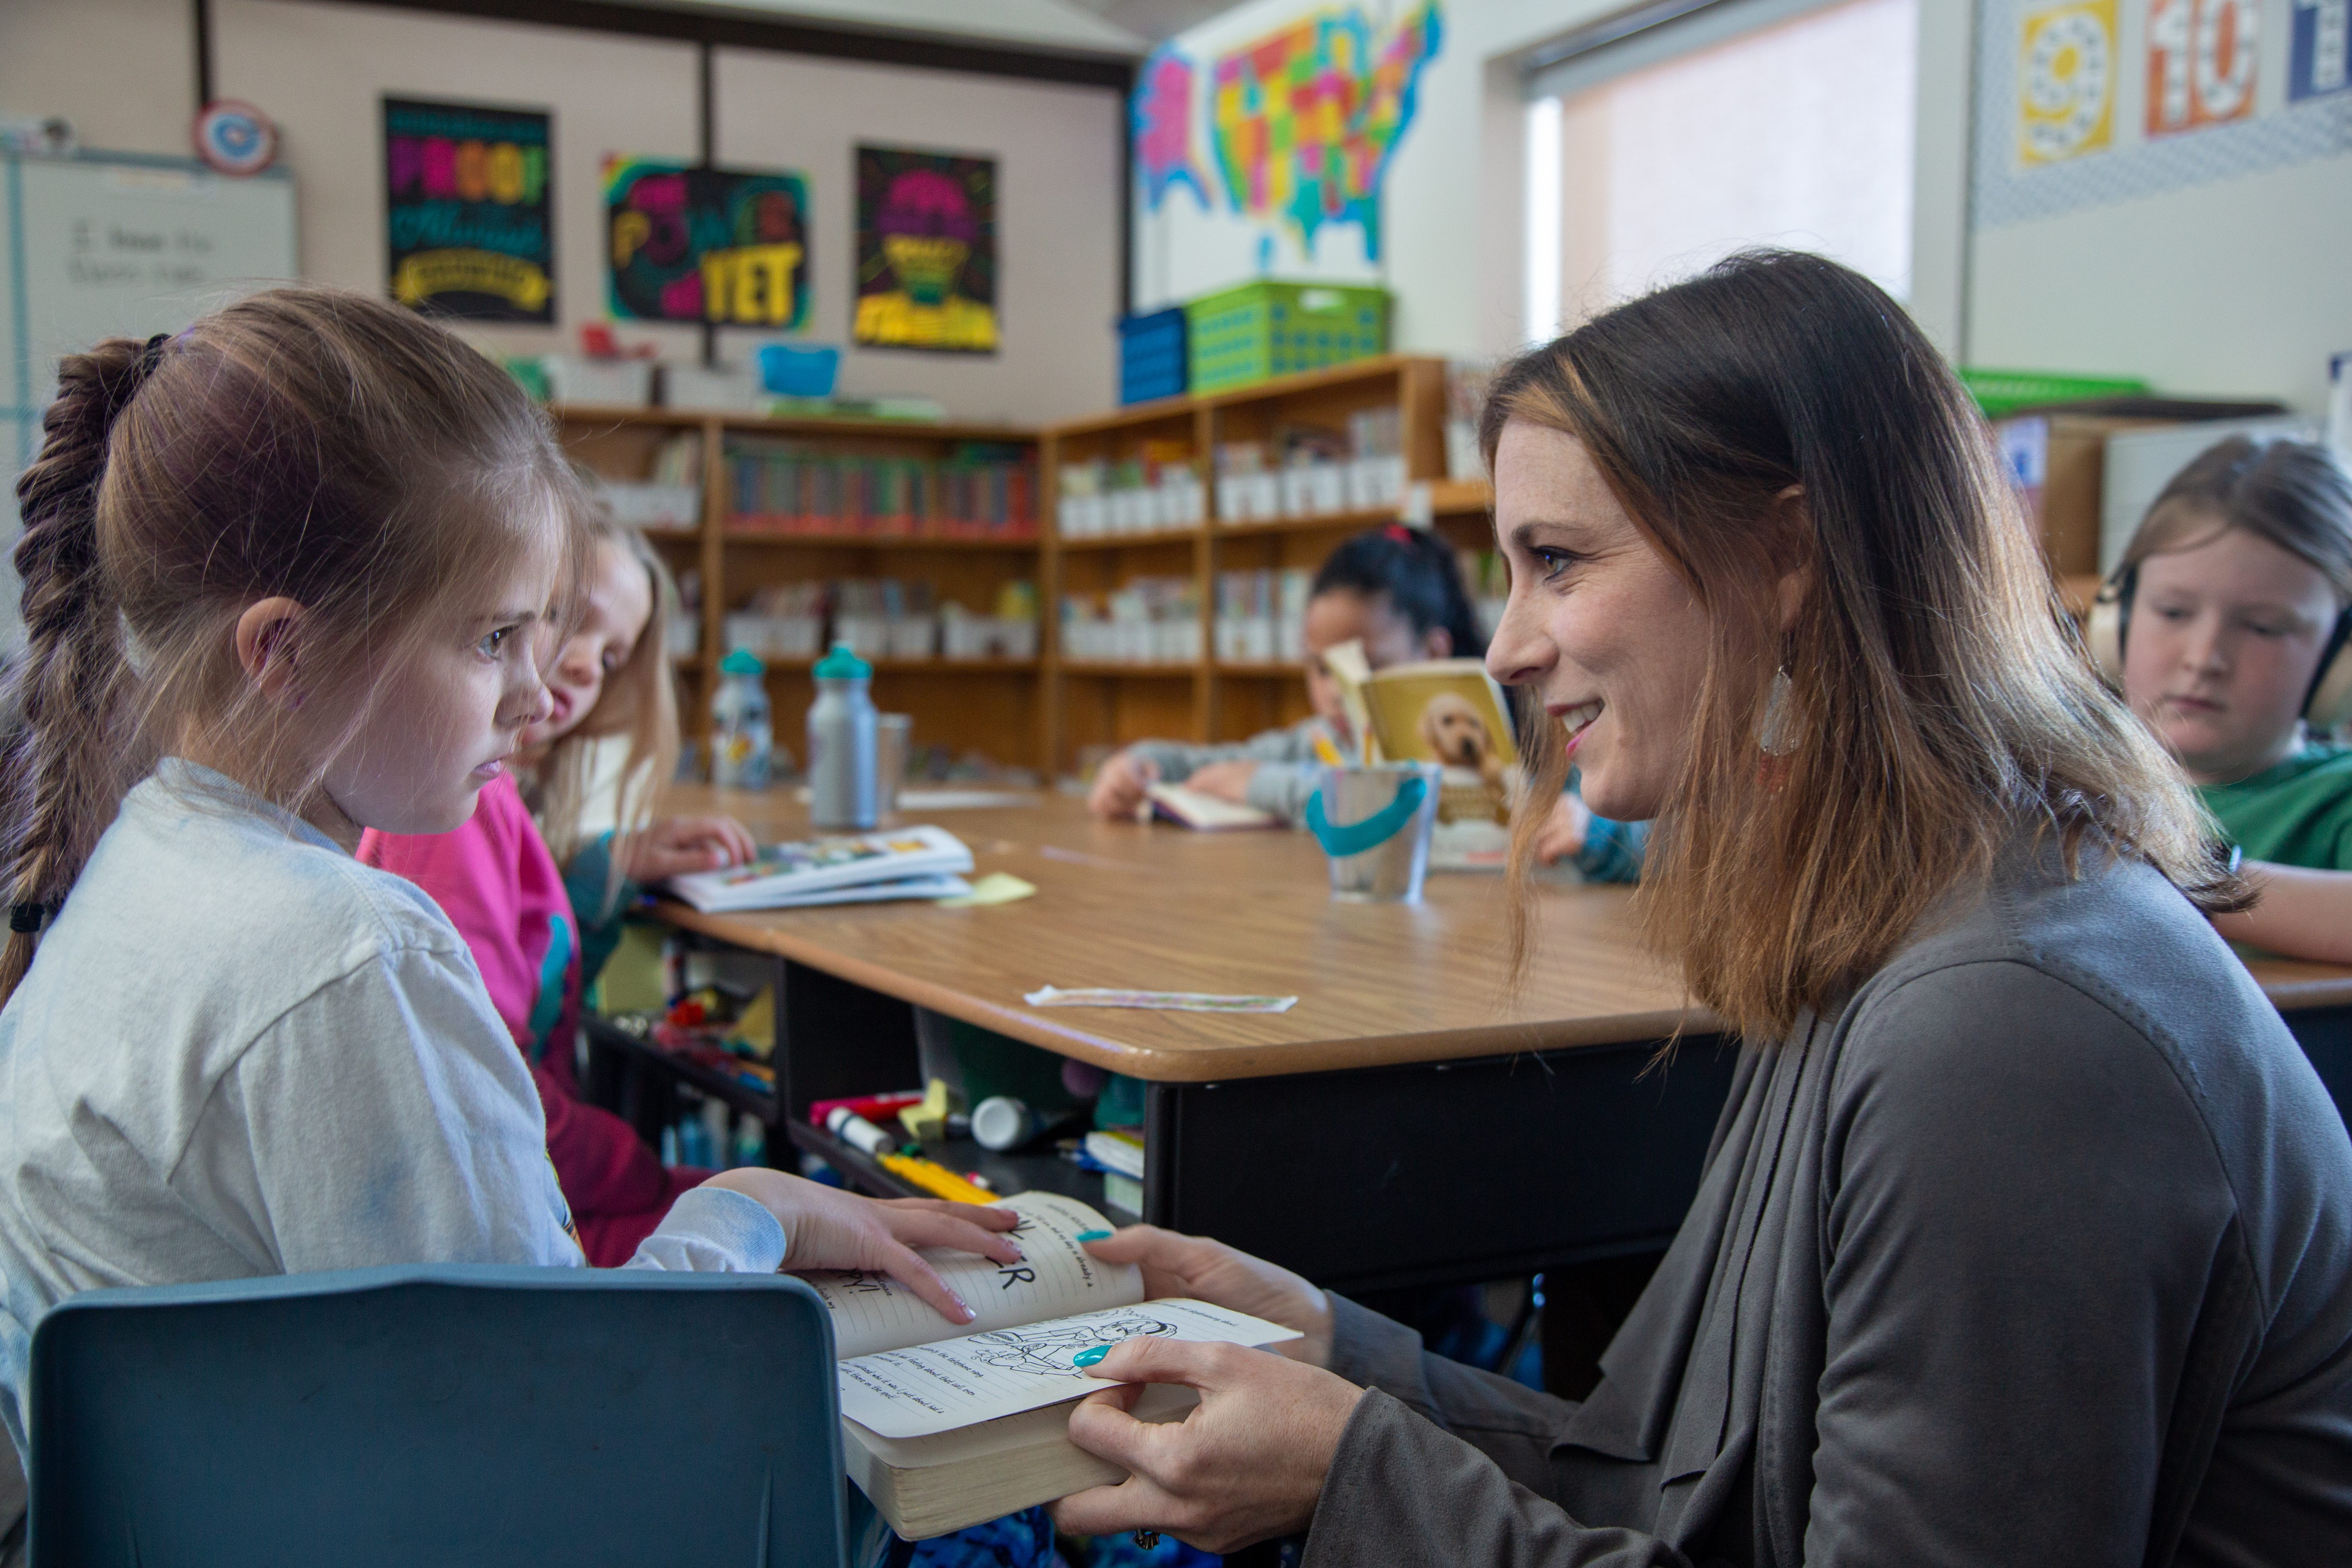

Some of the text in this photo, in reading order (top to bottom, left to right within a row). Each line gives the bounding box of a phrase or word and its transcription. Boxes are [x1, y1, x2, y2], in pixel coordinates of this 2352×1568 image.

[2153, 0, 2257, 122] 10
[2030, 16, 2105, 154] 9
[699, 241, 804, 324] YET
[1076, 1256, 1092, 1280] already
[851, 1373, 866, 1383] there
[908, 1358, 925, 1369] feeling
[924, 1368, 943, 1377] about
[939, 1376, 956, 1384] that
[948, 1357, 972, 1371] telephone
[853, 1364, 876, 1374] realized
[912, 1397, 932, 1406] about
